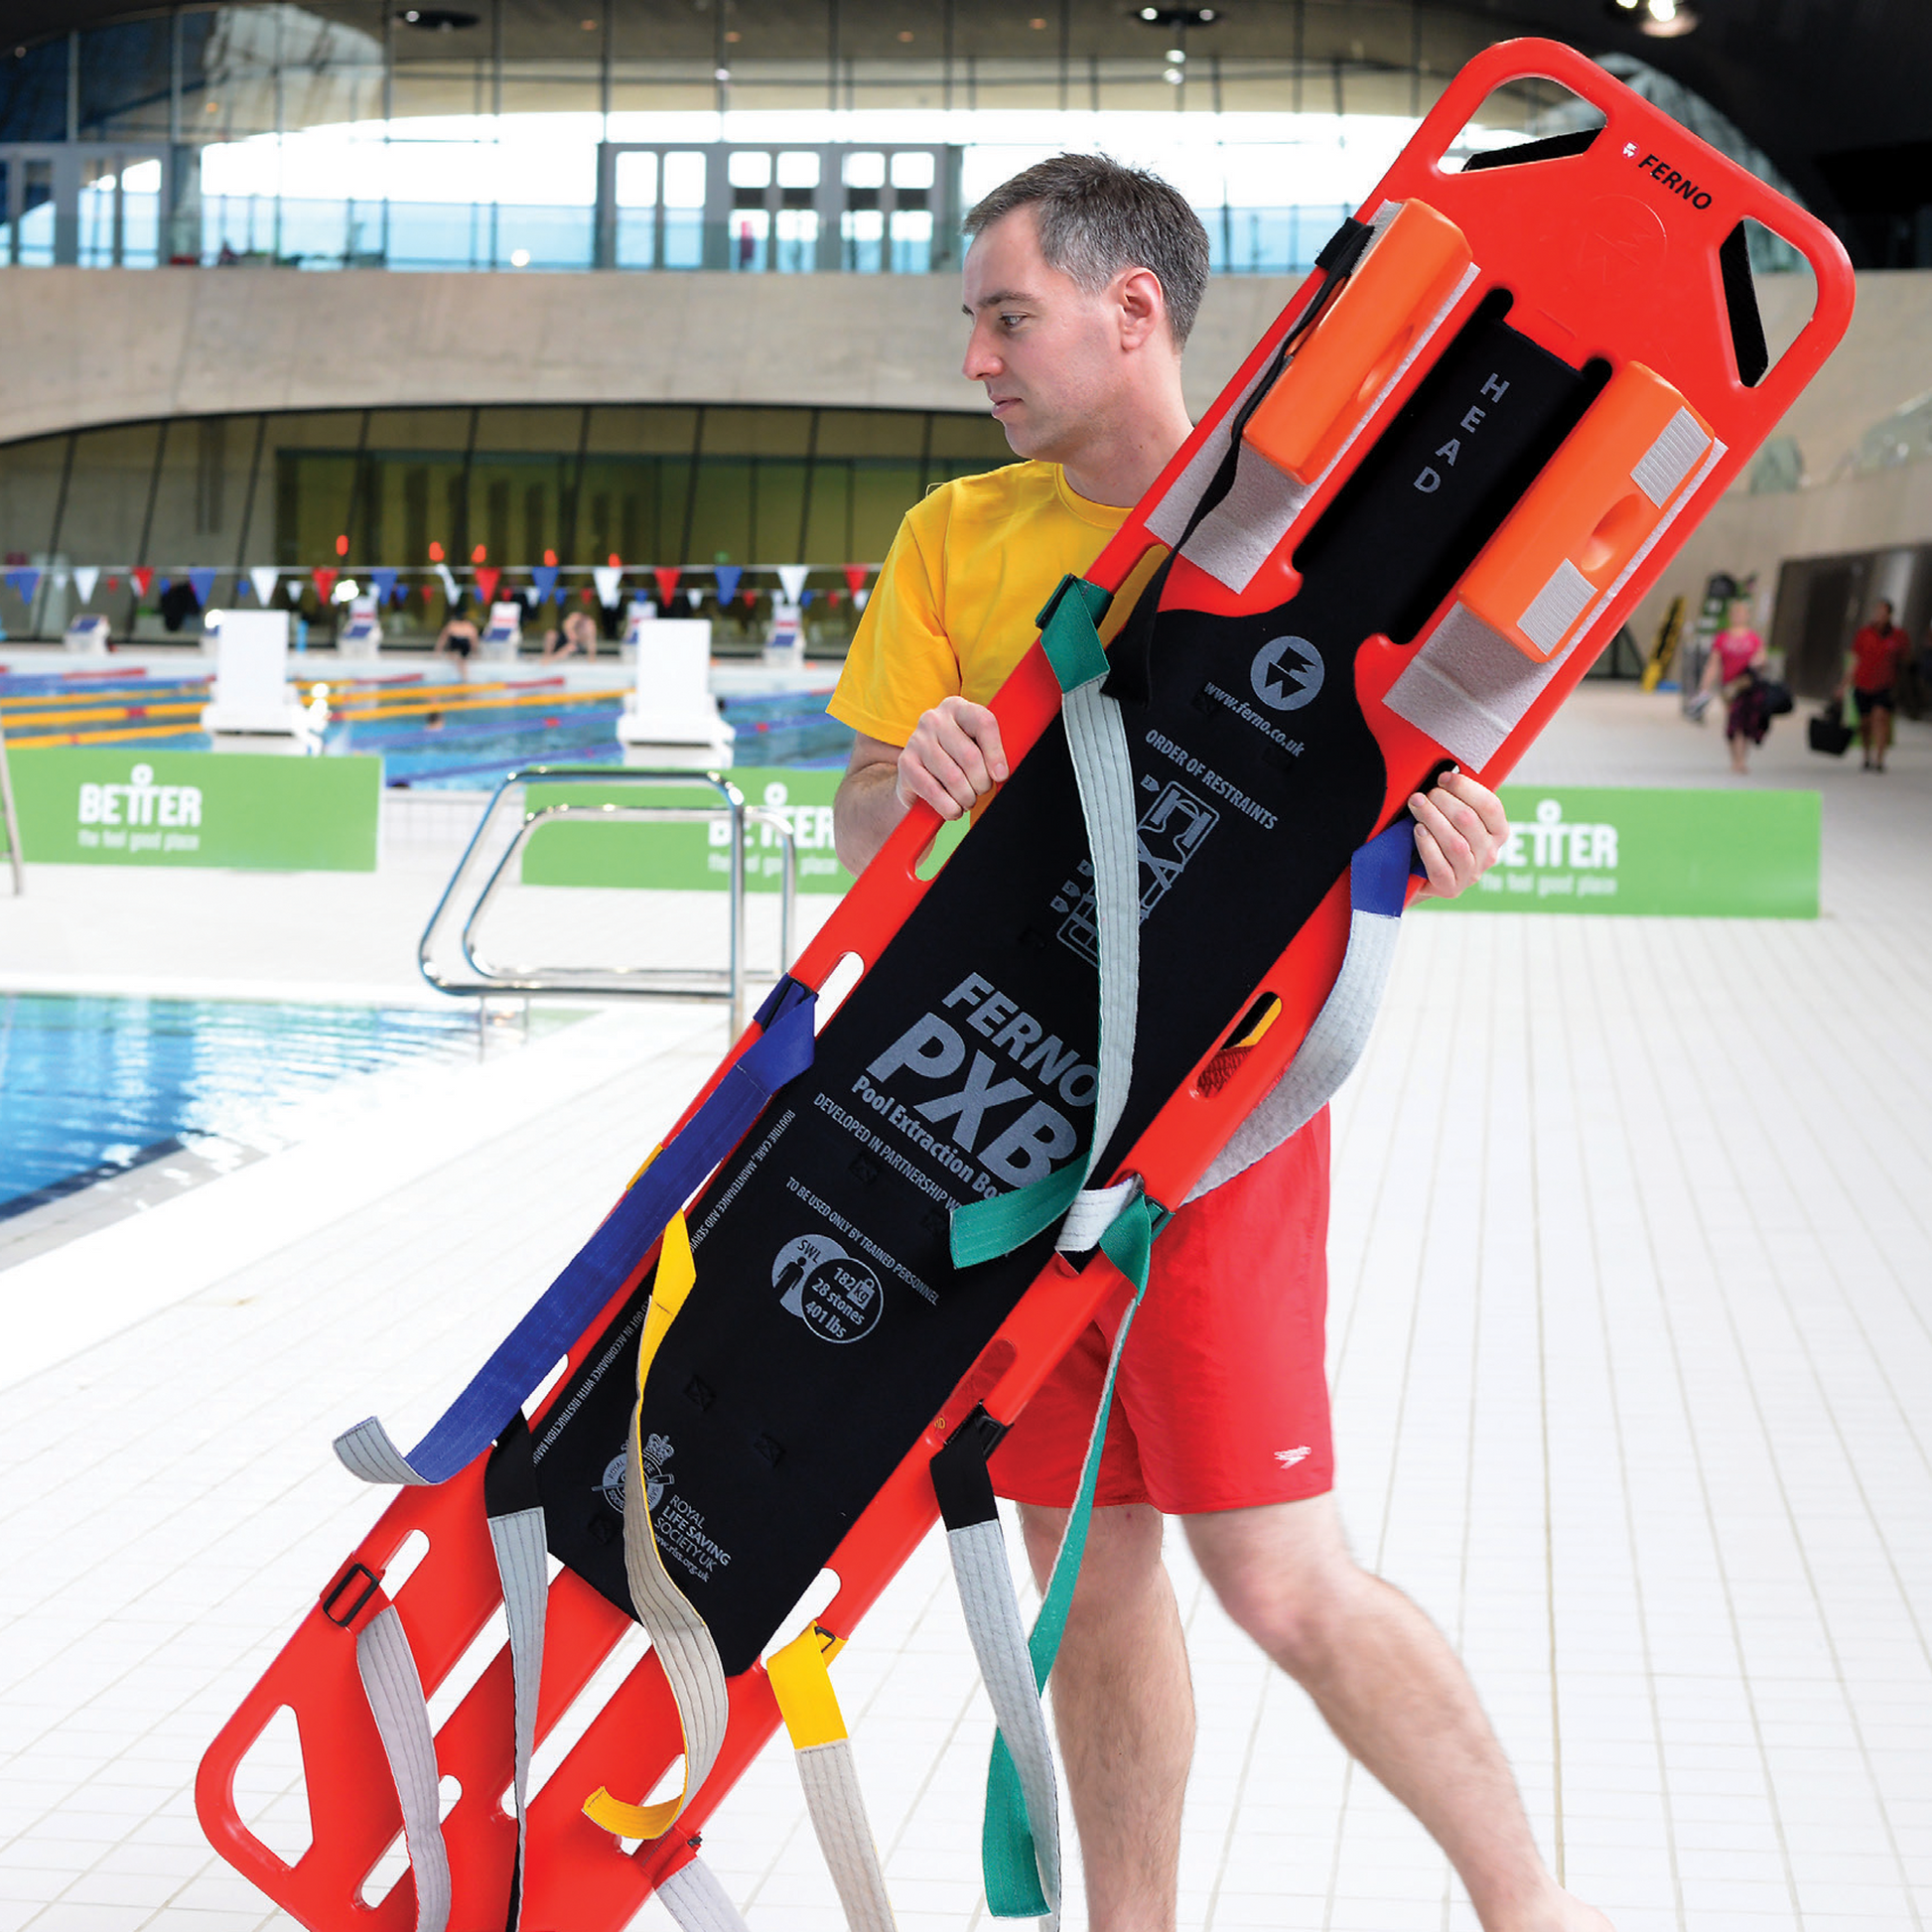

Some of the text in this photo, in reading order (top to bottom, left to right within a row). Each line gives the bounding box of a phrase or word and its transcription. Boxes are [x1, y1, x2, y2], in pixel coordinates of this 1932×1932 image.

[1638, 154, 1712, 209] FERNO
[1413, 372, 1510, 493] HEAD
[1203, 681, 1306, 758] www.ferno.co.uk
[78, 782, 203, 827] BETTER
[1145, 729, 1279, 830] ORDER OF RESTRAINTS
[1495, 822, 1618, 869] ETTER
[942, 972, 1099, 1107] FERNO
[866, 1012, 1077, 1189] PXB
[766, 1109, 795, 1144] ROUTINE
[813, 1092, 948, 1202] DEVELOPED IN PARTNERSHIP
[851, 1075, 896, 1116] Pool
[888, 1104, 975, 1183] Extraction
[716, 1160, 758, 1213] MAINTENANCE
[704, 1208, 721, 1228] AND
[785, 1176, 939, 1306] TO BE USED ONLY BY TRAINED PERSONNEL
[797, 1239, 821, 1264] SWL
[811, 1278, 865, 1325] 28 stones
[833, 1267, 856, 1291] 182
[805, 1301, 847, 1338] 401 lbs
[590, 1333, 627, 1382] ACCORDANCE
[576, 1378, 596, 1401] WITH
[543, 1397, 582, 1446] INSTRUCTION
[662, 1505, 732, 1567] LIFE SAVING
[669, 1494, 705, 1529] ROYAL
[654, 1517, 717, 1572] SOCIETY UK
